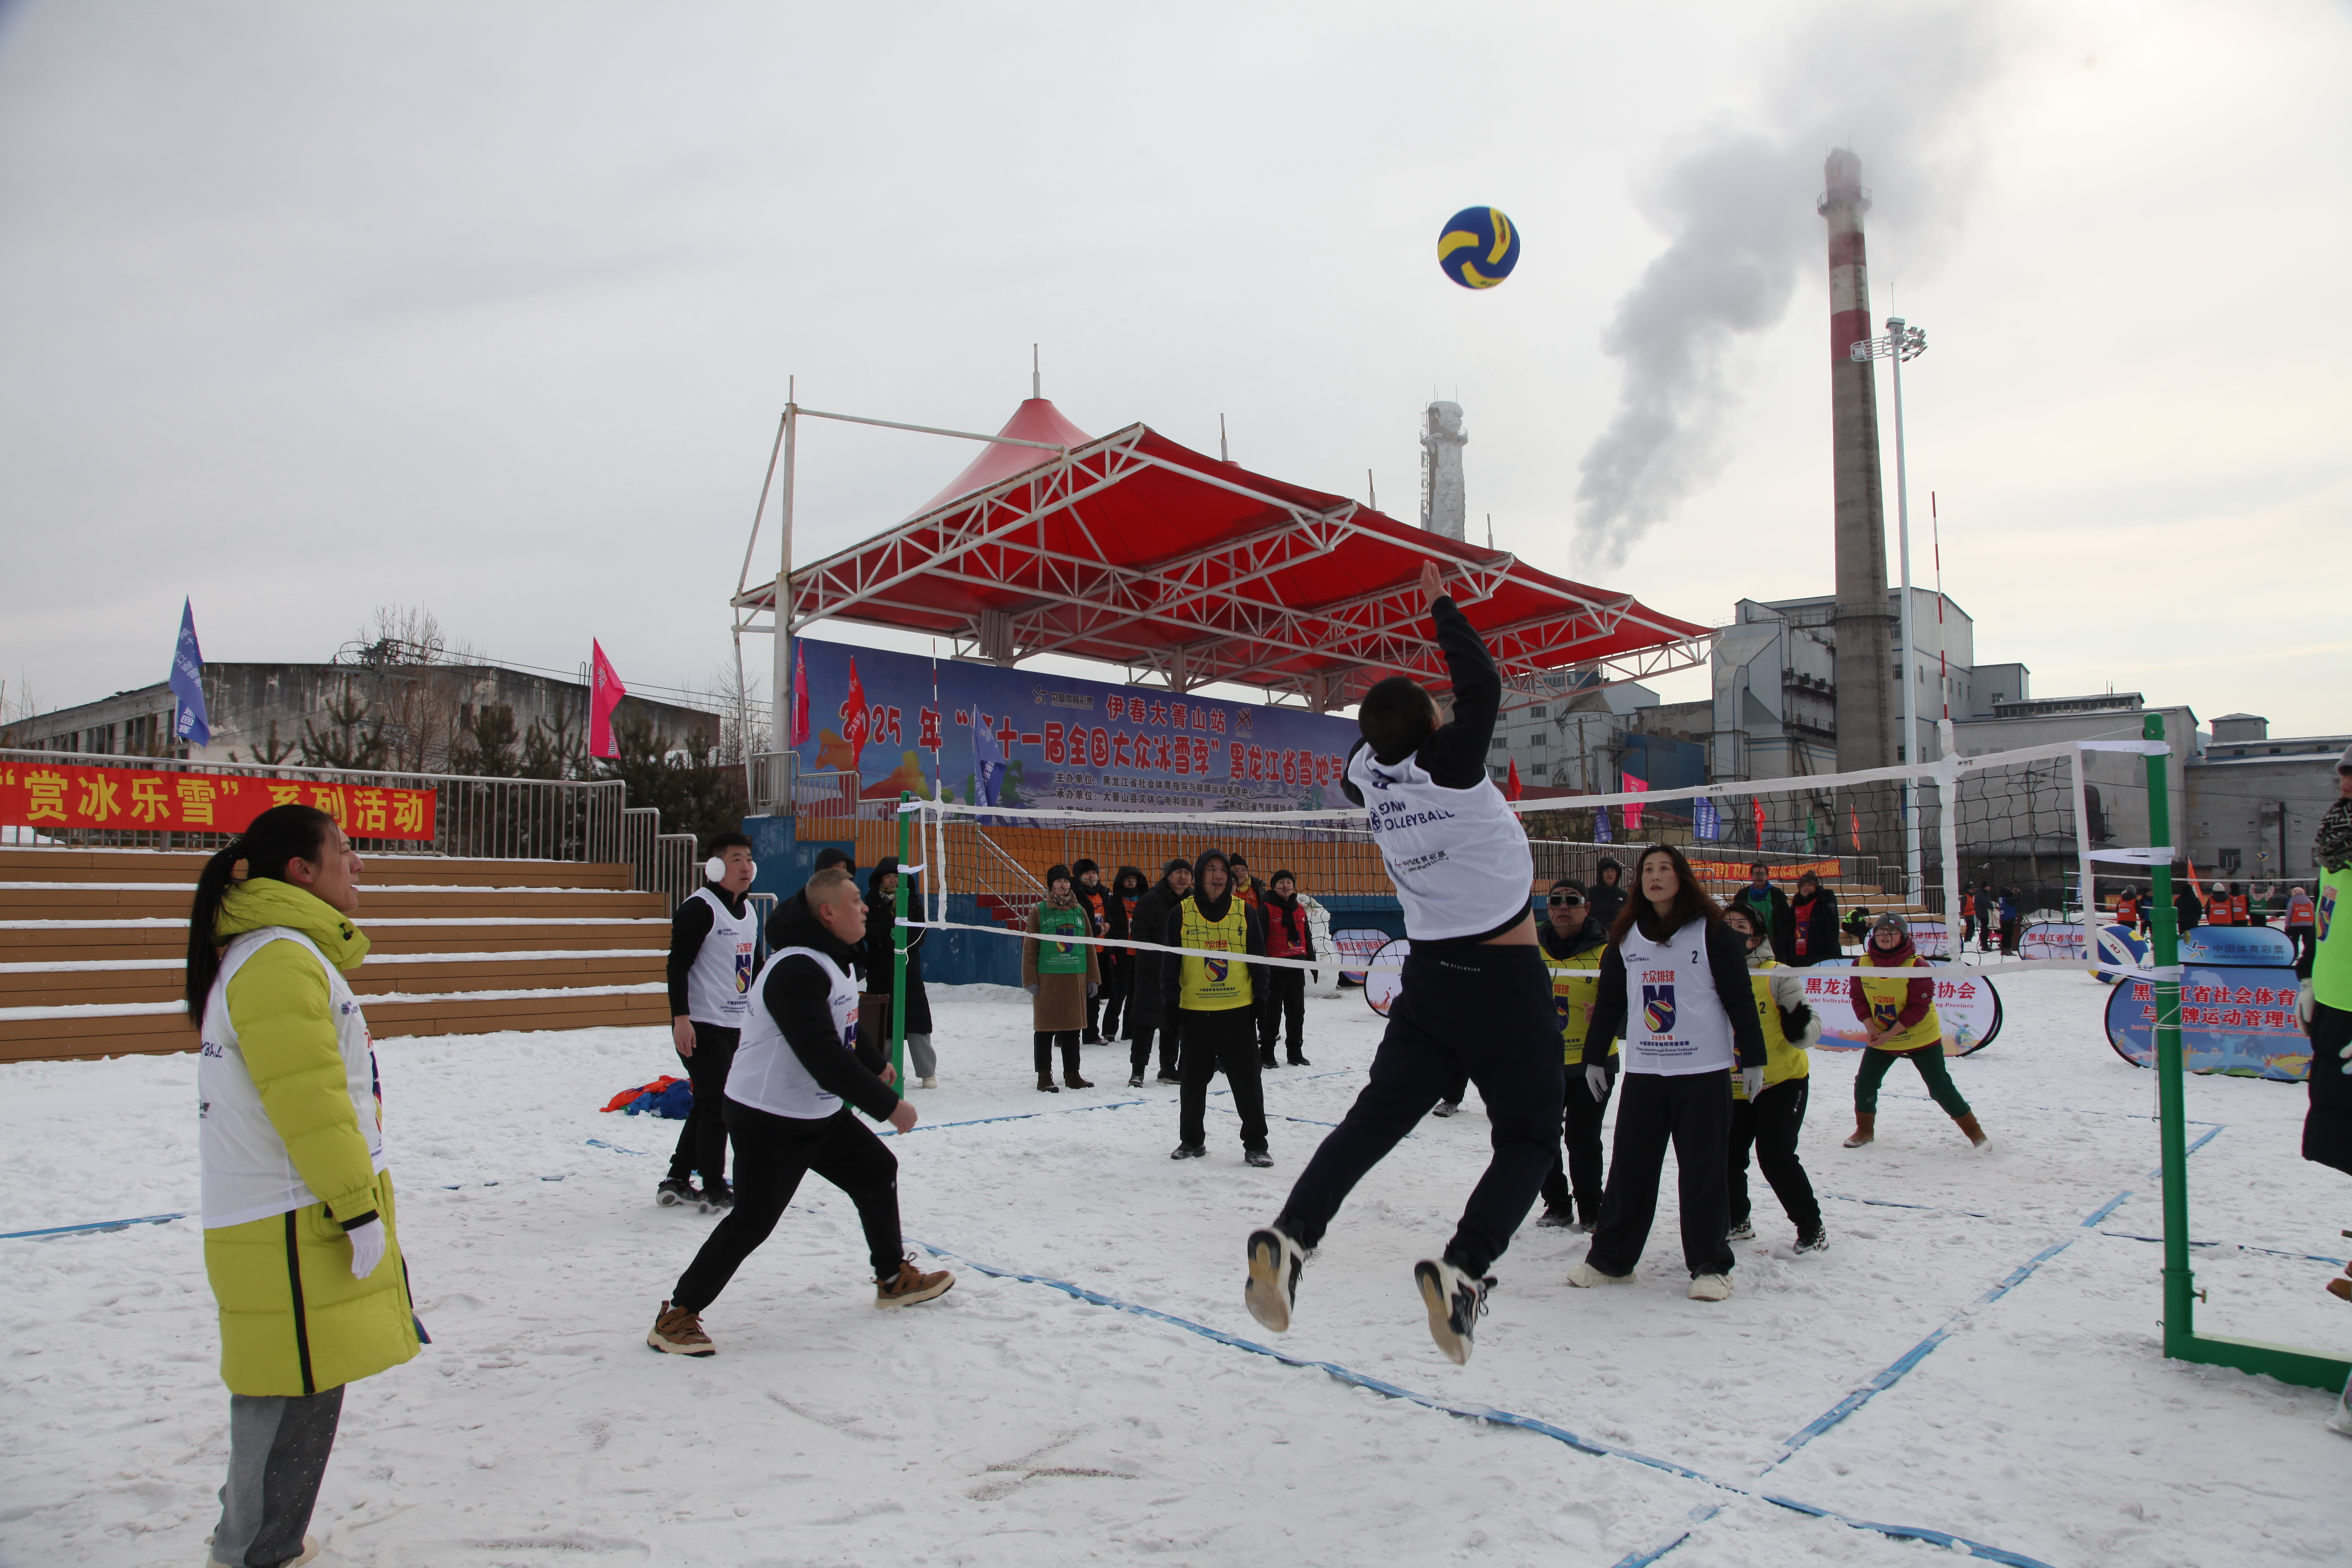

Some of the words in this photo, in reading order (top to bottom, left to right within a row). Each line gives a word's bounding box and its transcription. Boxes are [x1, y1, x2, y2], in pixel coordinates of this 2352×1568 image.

[1050, 692, 1093, 706] 中国体育彩票
[1106, 693, 1226, 734] 伊春大箐山站
[919, 706, 943, 753] 年
[956, 708, 1220, 776] “十一届全国大众冰雪季”
[1229, 741, 1348, 789] 黑龙江省雪地气
[1385, 810, 1455, 830] OLLEYBALL
[1238, 926, 1243, 936] 5
[2028, 933, 2086, 943] 黑龙江省气排
[736, 943, 752, 953] 大众排球
[2213, 944, 2284, 954] 中国体育彩票
[1692, 950, 1698, 964] 2
[1642, 970, 1675, 983] 大众排球
[1553, 984, 1569, 995] 排球
[1932, 982, 1976, 1000] 协会
[1872, 995, 1895, 1004] 大众排球
[1759, 1002, 1765, 1014] 2
[2141, 1005, 2298, 1029] 与牌运动管理中
